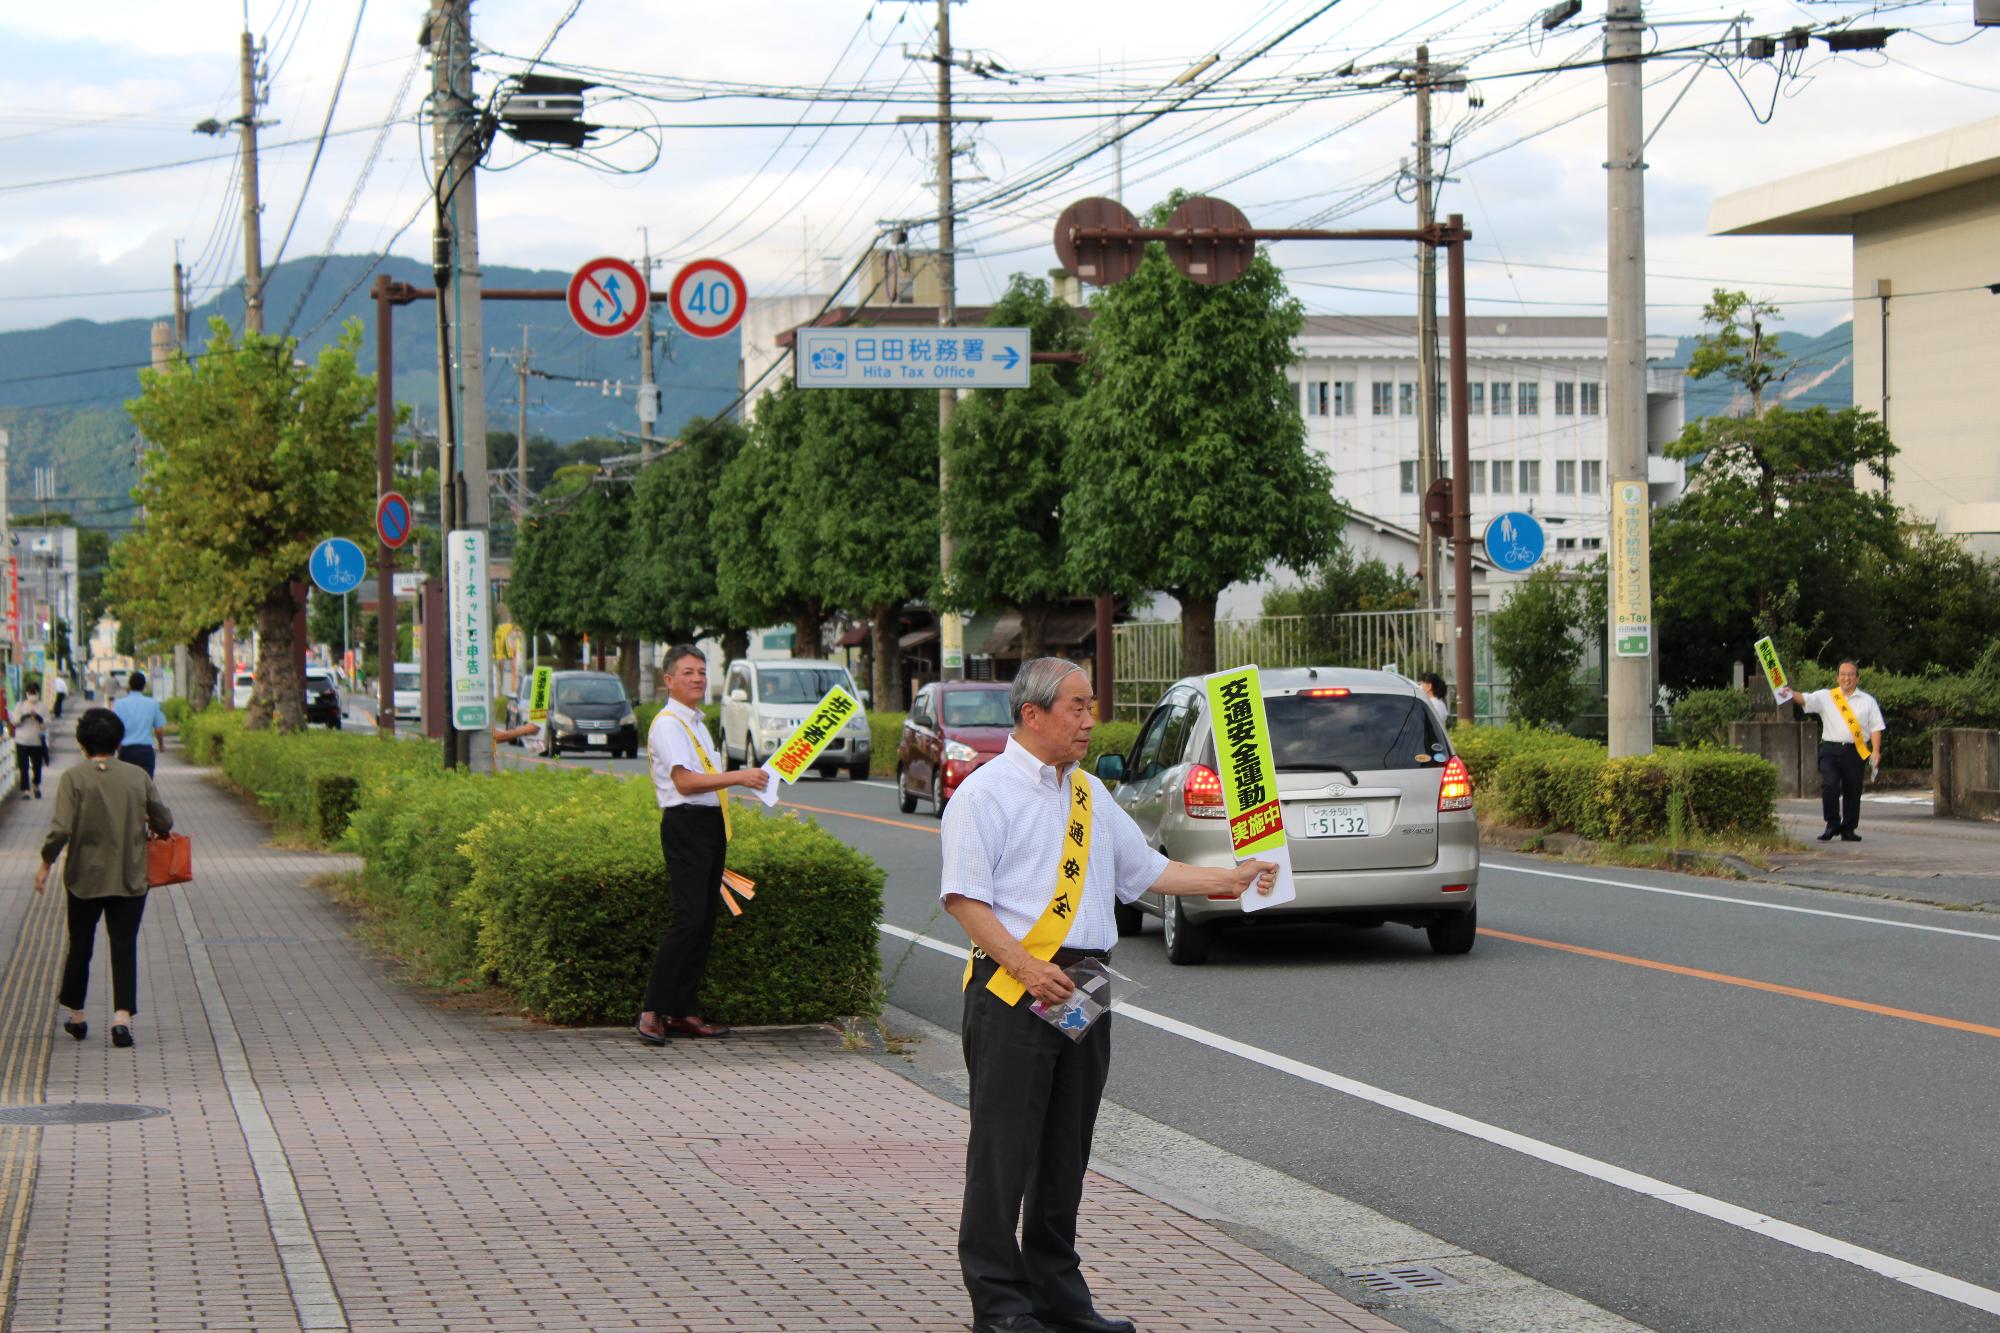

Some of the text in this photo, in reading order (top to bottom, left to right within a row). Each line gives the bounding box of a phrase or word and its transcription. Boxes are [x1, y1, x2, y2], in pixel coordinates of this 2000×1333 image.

[688, 282, 729, 315] 40
[855, 338, 985, 362] 日田税務署
[864, 365, 975, 378] Hita Tax Office
[1619, 613, 1648, 623] e-Tax
[775, 695, 852, 775] 歩行者注意
[1220, 677, 1265, 811] 交通安全運動
[1232, 805, 1281, 845] 実施中
[1320, 818, 1365, 833] 51-32
